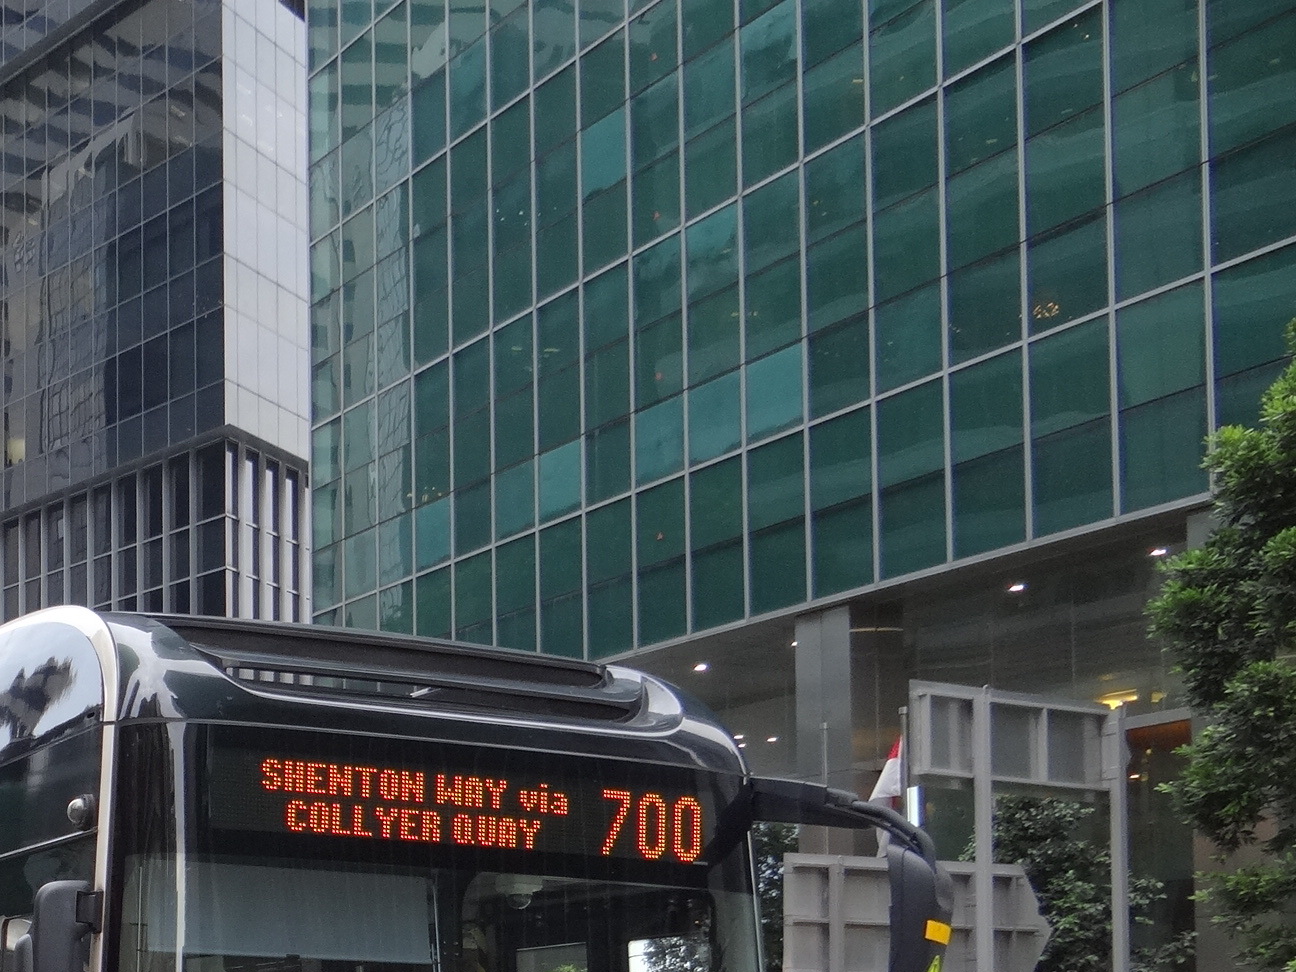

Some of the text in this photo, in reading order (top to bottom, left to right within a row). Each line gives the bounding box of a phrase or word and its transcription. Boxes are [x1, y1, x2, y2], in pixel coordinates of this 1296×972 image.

[261, 758, 569, 817] SHENTON WAY via
[287, 799, 542, 850] COLLYER QUAY
[602, 789, 702, 862] 700
